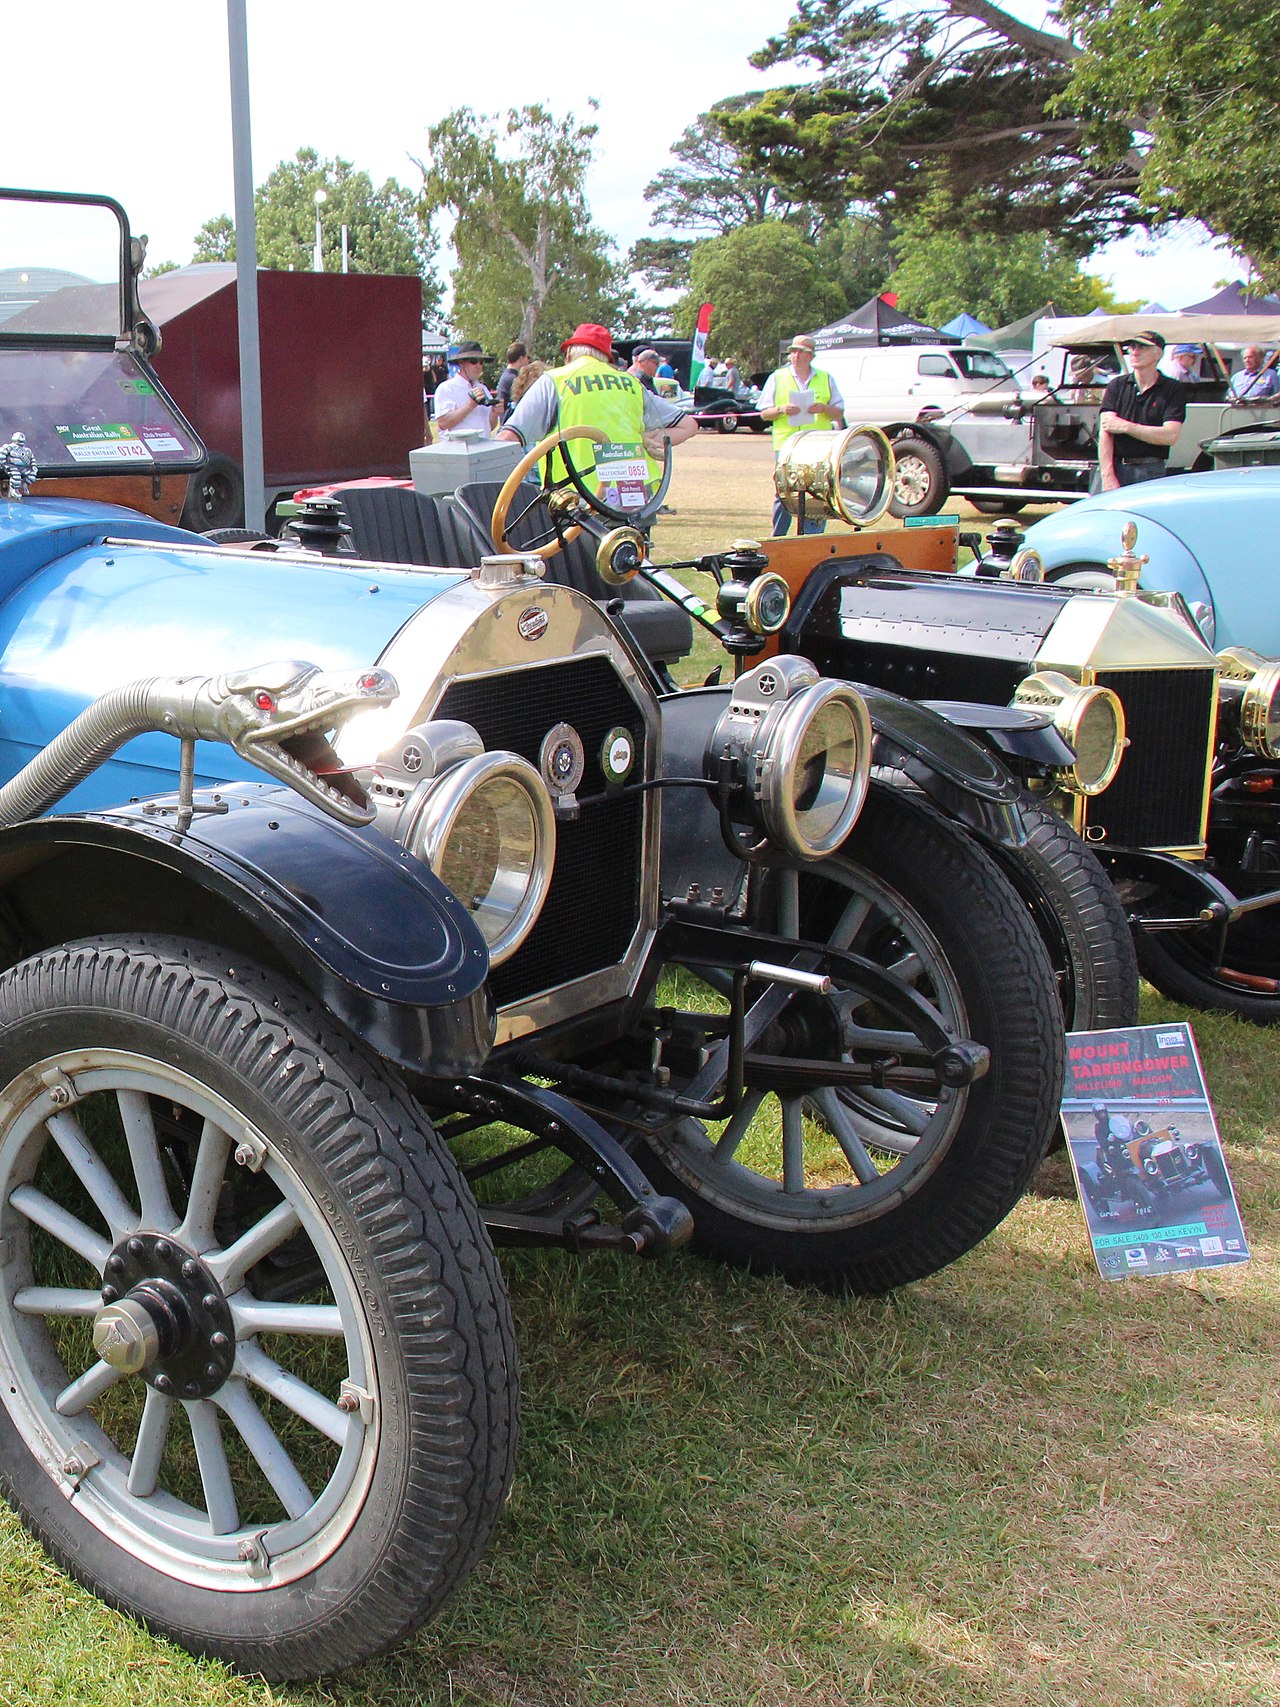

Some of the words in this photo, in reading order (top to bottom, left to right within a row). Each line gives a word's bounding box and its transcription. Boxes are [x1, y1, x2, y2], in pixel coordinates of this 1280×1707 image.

[564, 373, 637, 396] VHRR
[117, 445, 146, 456] 0742
[628, 465, 646, 476] 0852
[1069, 1041, 1129, 1060] MOUNT
[1071, 1055, 1189, 1079] TARRENGOWER
[1075, 1079, 1122, 1092] HILLCLIMB
[1132, 1074, 1173, 1086] MALDON
[1095, 1238, 1110, 1248] FOR
[1112, 1235, 1130, 1245] SALE
[1132, 1233, 1149, 1242] 0409
[1165, 1229, 1176, 1237] 452
[1178, 1226, 1202, 1236] KEVYN
[319, 1192, 387, 1337] DUNLOP
